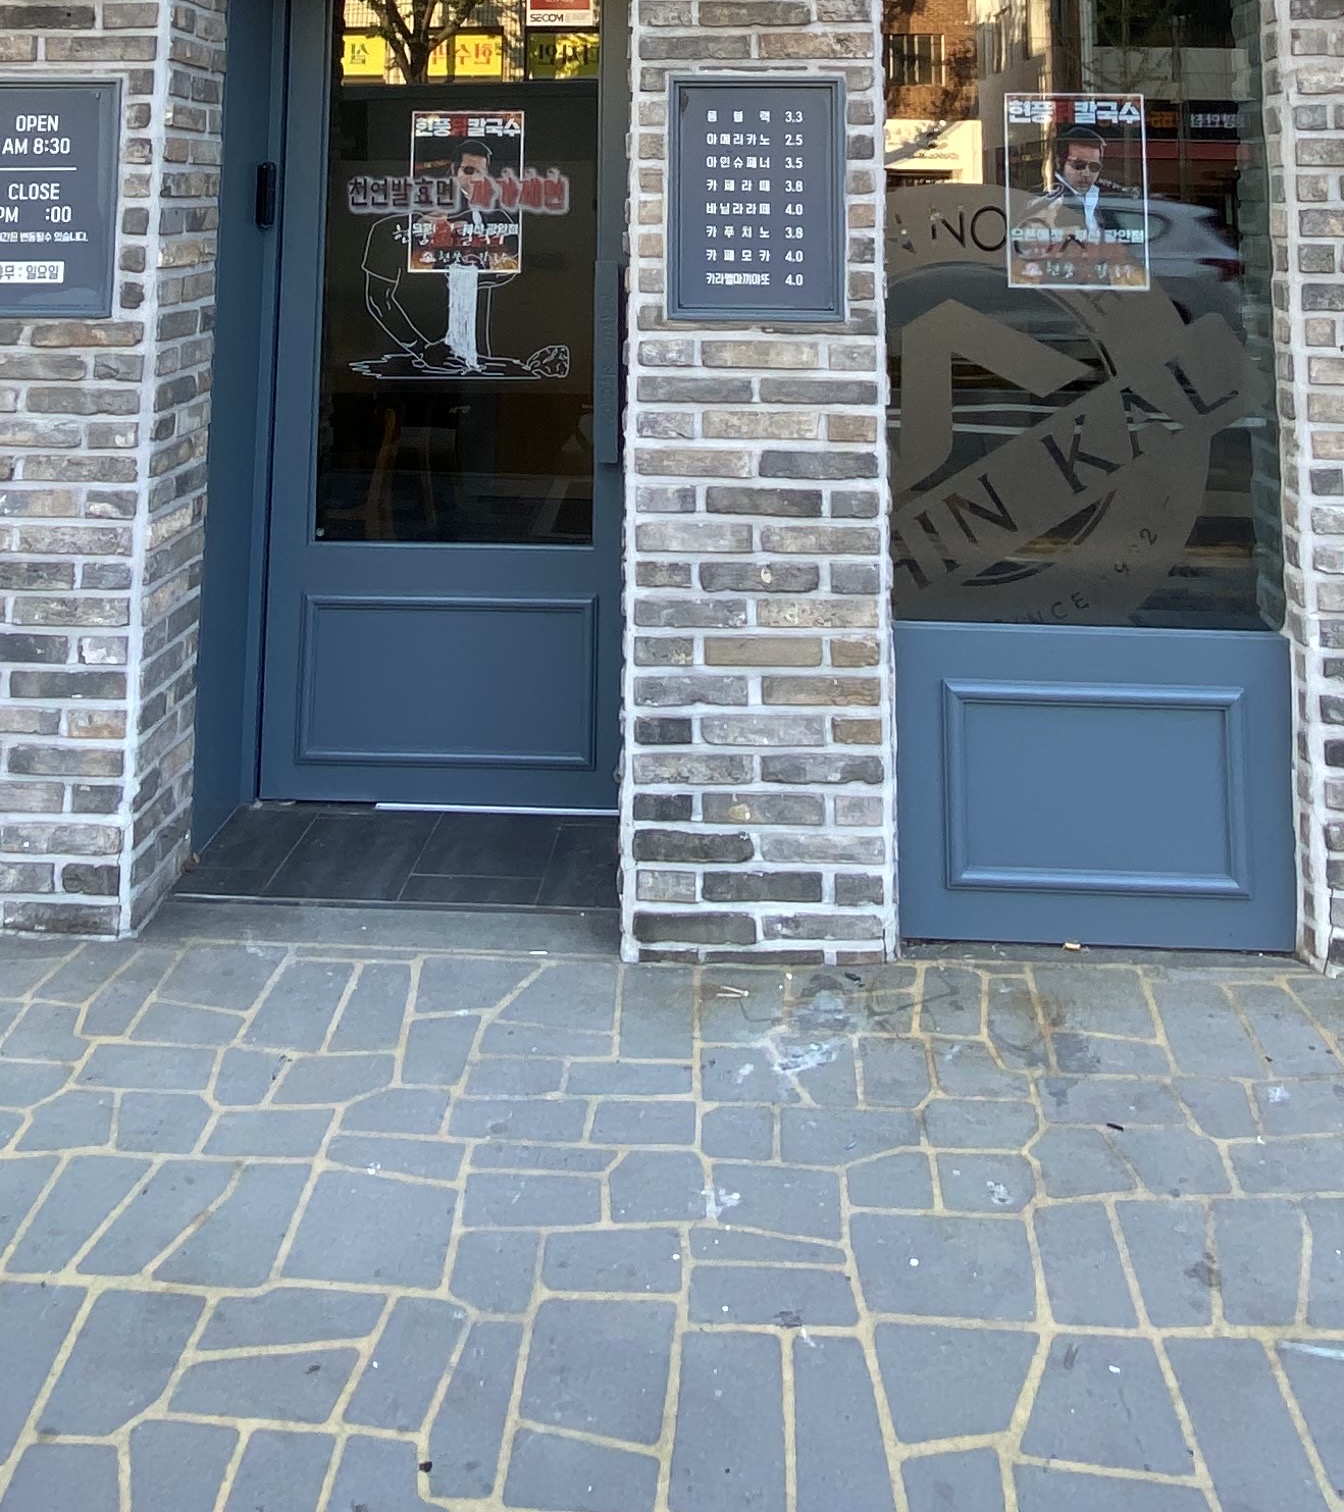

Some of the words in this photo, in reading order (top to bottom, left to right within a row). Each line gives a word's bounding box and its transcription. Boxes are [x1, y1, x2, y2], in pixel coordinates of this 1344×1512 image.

[529, 13, 565, 23] SECOM
[15, 114, 60, 132] OPEN
[785, 110, 804, 123] 3.3
[1, 138, 28, 155] AM
[33, 137, 71, 155] 8:30
[706, 133, 771, 146] 아메리카노
[784, 133, 804, 146] 2.5
[784, 156, 804, 169] 3.5
[8, 183, 61, 201] CLOSE
[784, 179, 804, 192] 3.8
[784, 203, 804, 216] 4.0
[784, 226, 804, 239] 3.8
[784, 250, 804, 262] 4.0
[26, 264, 59, 280] 일요일
[784, 273, 804, 286] 4.0
